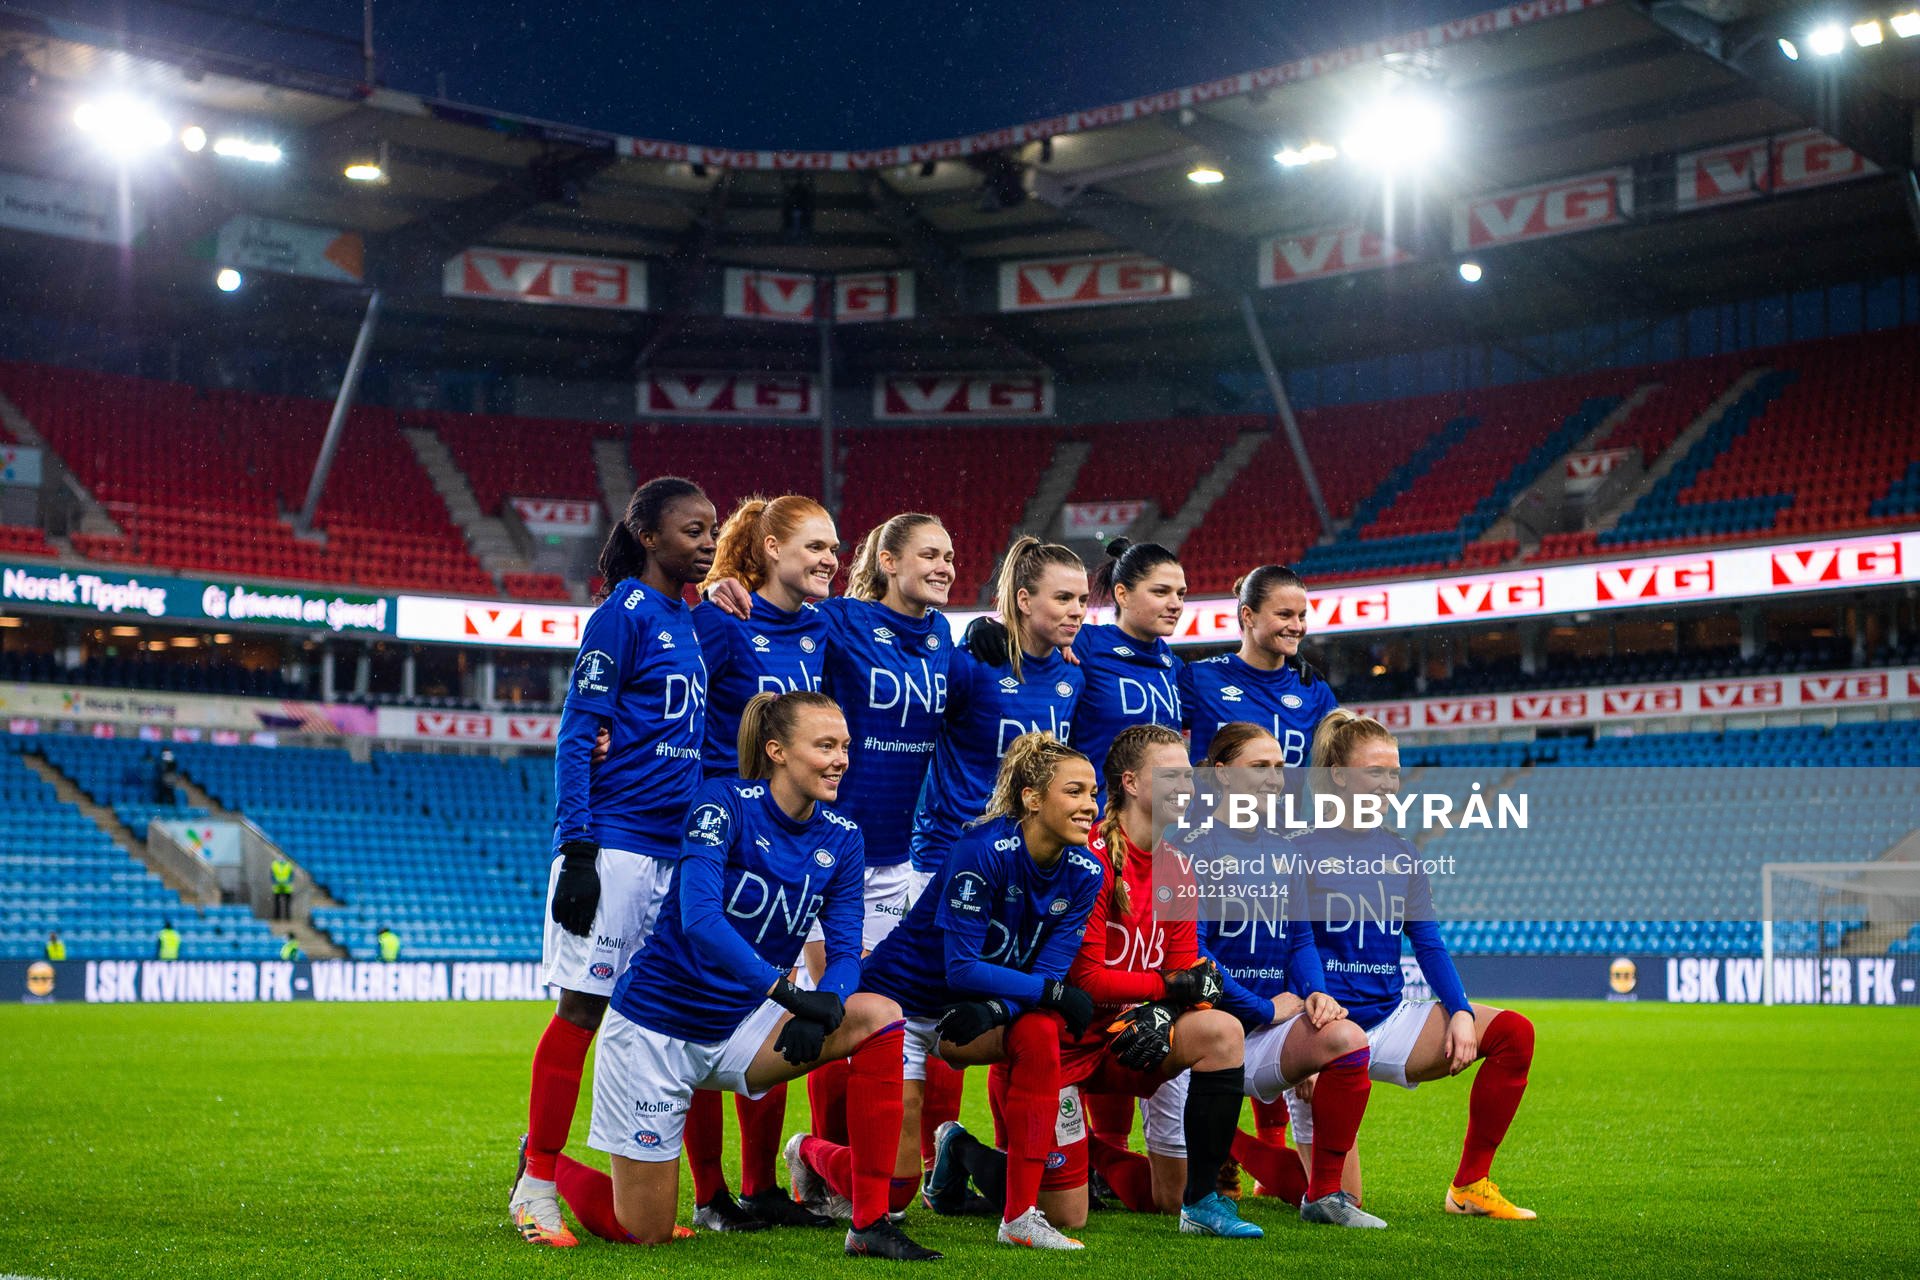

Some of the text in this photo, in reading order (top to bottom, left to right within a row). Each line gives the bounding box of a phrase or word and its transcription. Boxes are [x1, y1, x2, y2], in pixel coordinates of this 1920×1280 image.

[1702, 139, 1857, 198] VG
[1475, 181, 1611, 243] VG
[470, 257, 1166, 316] VG VG VG
[655, 378, 1036, 412] VG VG
[519, 501, 1139, 523] VG VG
[1599, 563, 1711, 601] VG
[1773, 544, 1897, 584] VG
[3, 568, 76, 602] Norsk
[77, 574, 166, 616] Tipping
[624, 589, 645, 610] coop
[1305, 592, 1387, 626] VG
[1440, 578, 1541, 614] VG
[465, 610, 577, 639] VG
[869, 659, 947, 728] DNB
[1605, 688, 1678, 714] VG
[1703, 684, 1778, 709] VG
[1803, 675, 1882, 702] VG
[1427, 701, 1494, 725] VG
[1515, 695, 1583, 720] VG
[420, 714, 487, 739] VG
[823, 810, 858, 831] coop
[726, 871, 823, 944] DNB
[1326, 880, 1406, 949] DNB
[980, 919, 1043, 967] DN
[1105, 911, 1166, 973] DNB
[85, 961, 137, 1002] LSK
[142, 961, 255, 1002] KVINNER
[260, 961, 293, 1001] FK
[1667, 957, 1720, 1003] LSK
[1725, 957, 1851, 1003] KVNNER
[1857, 958, 1896, 1004] FK
